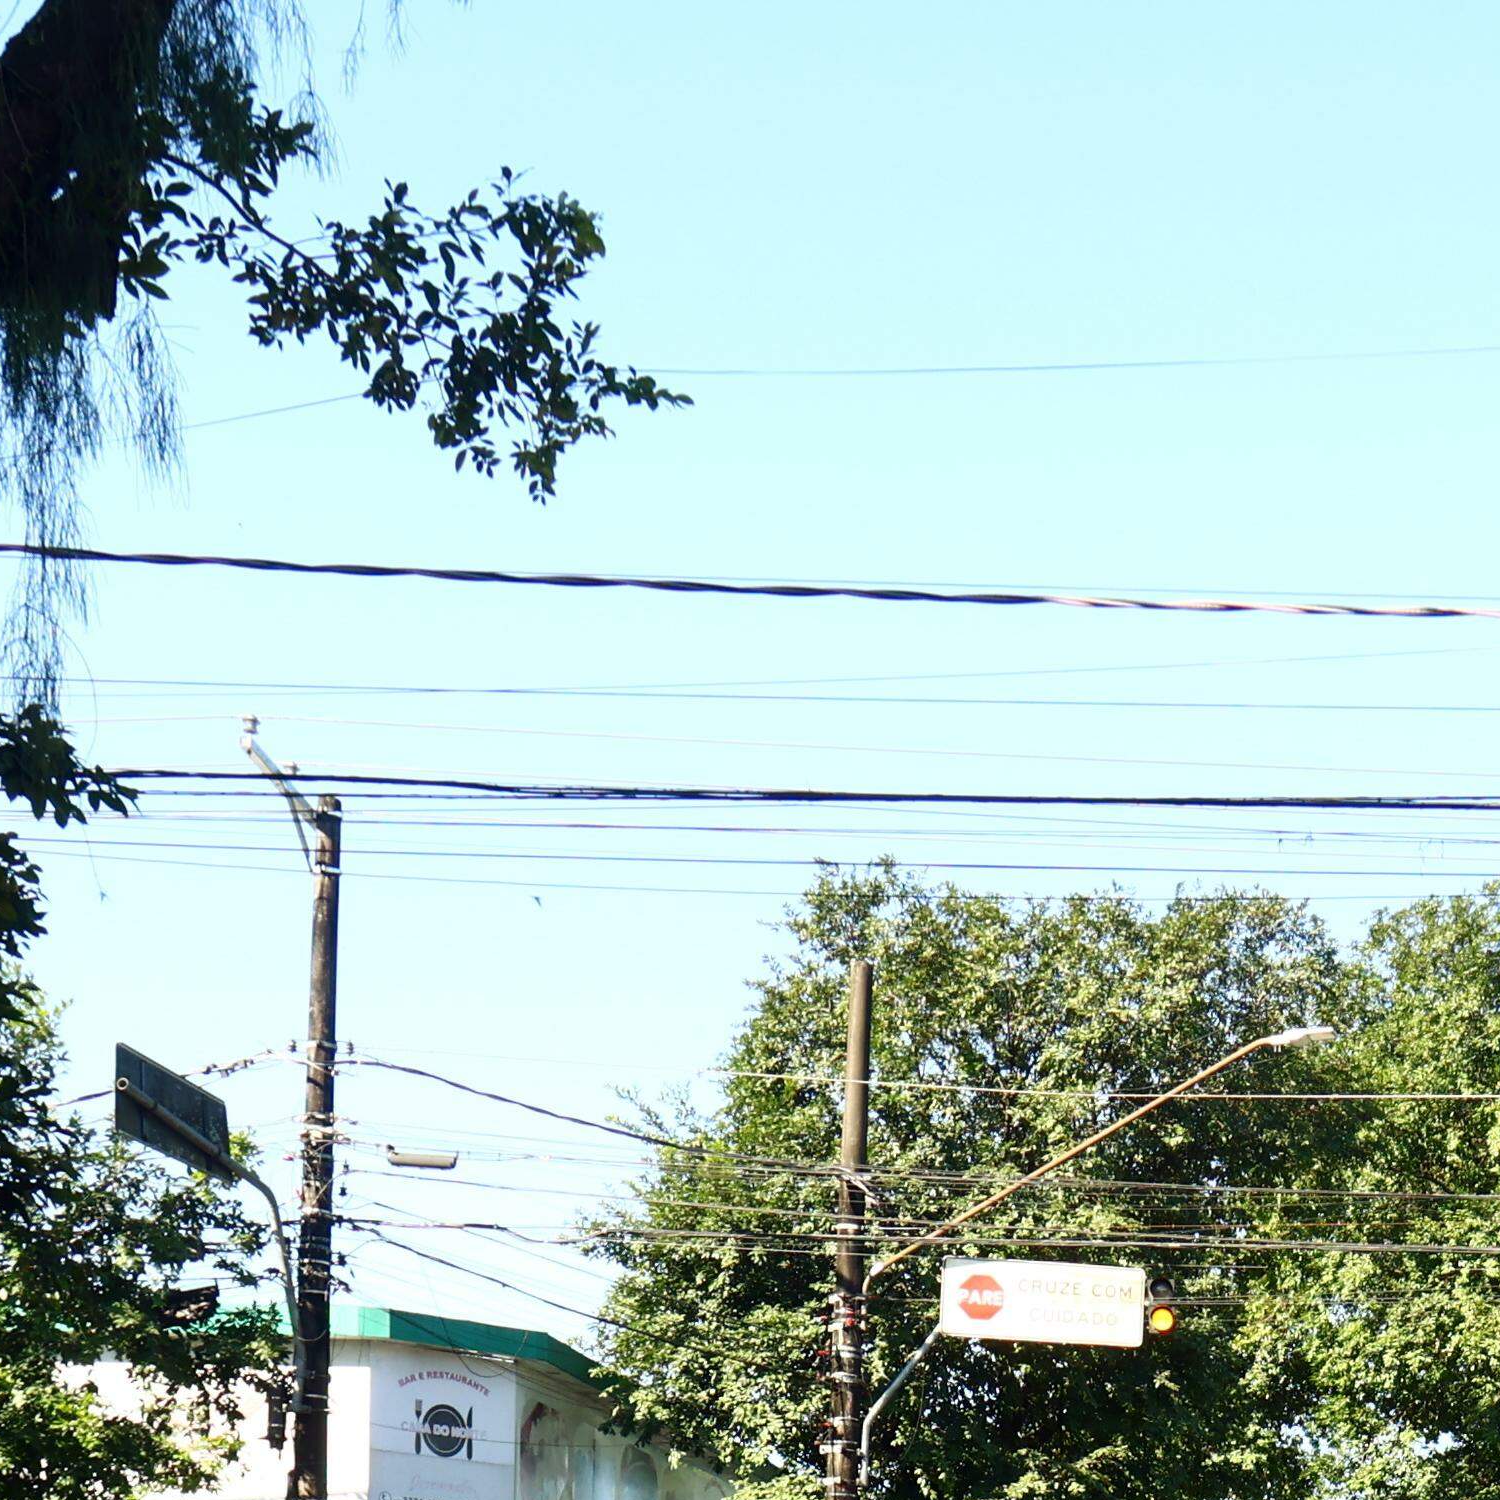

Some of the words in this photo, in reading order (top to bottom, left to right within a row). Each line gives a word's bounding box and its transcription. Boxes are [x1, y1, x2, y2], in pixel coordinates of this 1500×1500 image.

[957, 1288, 1005, 1308] PARE
[1018, 1278, 1081, 1297] CRUZE
[1092, 1284, 1133, 1299] COM
[1029, 1307, 1118, 1327] CUIDADO
[398, 1374, 417, 1387] BAR
[426, 1371, 492, 1397] RESTAURANTE
[433, 1424, 451, 1437] DO
